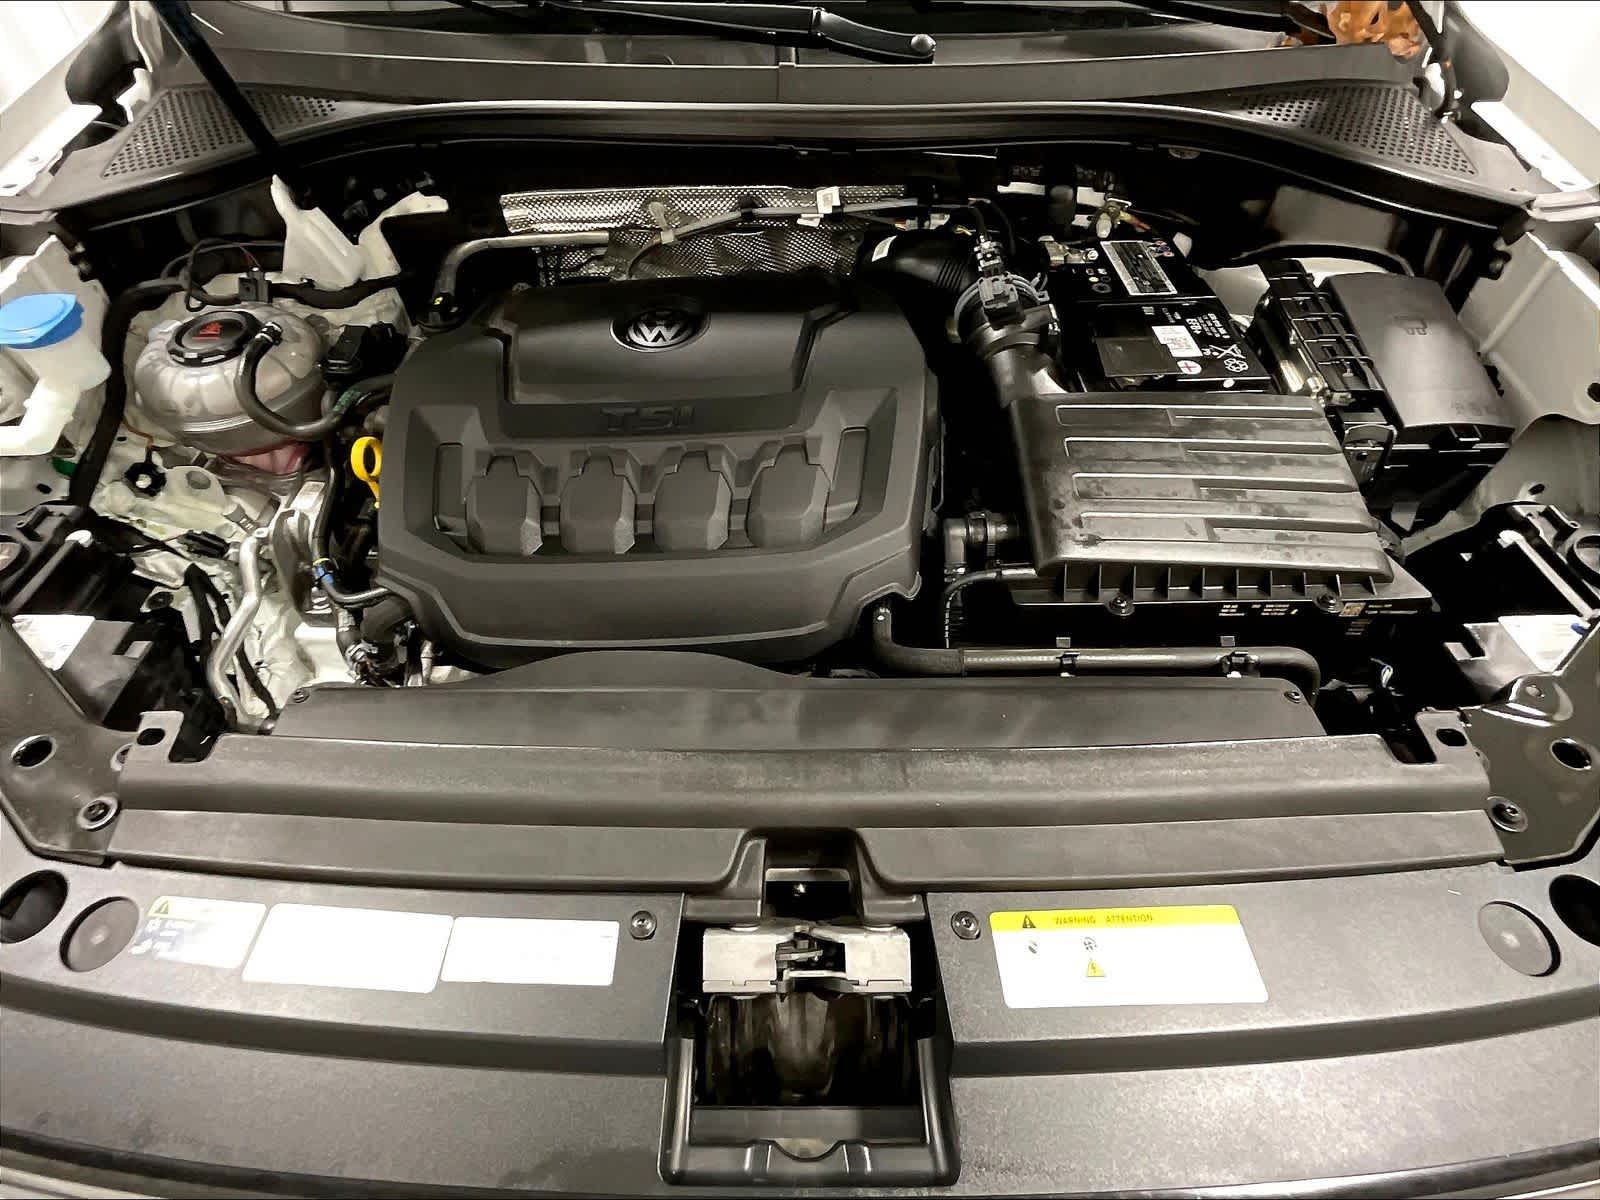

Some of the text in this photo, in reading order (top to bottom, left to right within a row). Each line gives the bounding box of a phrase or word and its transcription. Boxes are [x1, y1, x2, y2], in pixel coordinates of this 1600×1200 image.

[600, 405, 696, 432] TSI
[1053, 912, 1153, 925] WARNING ATTENTION
